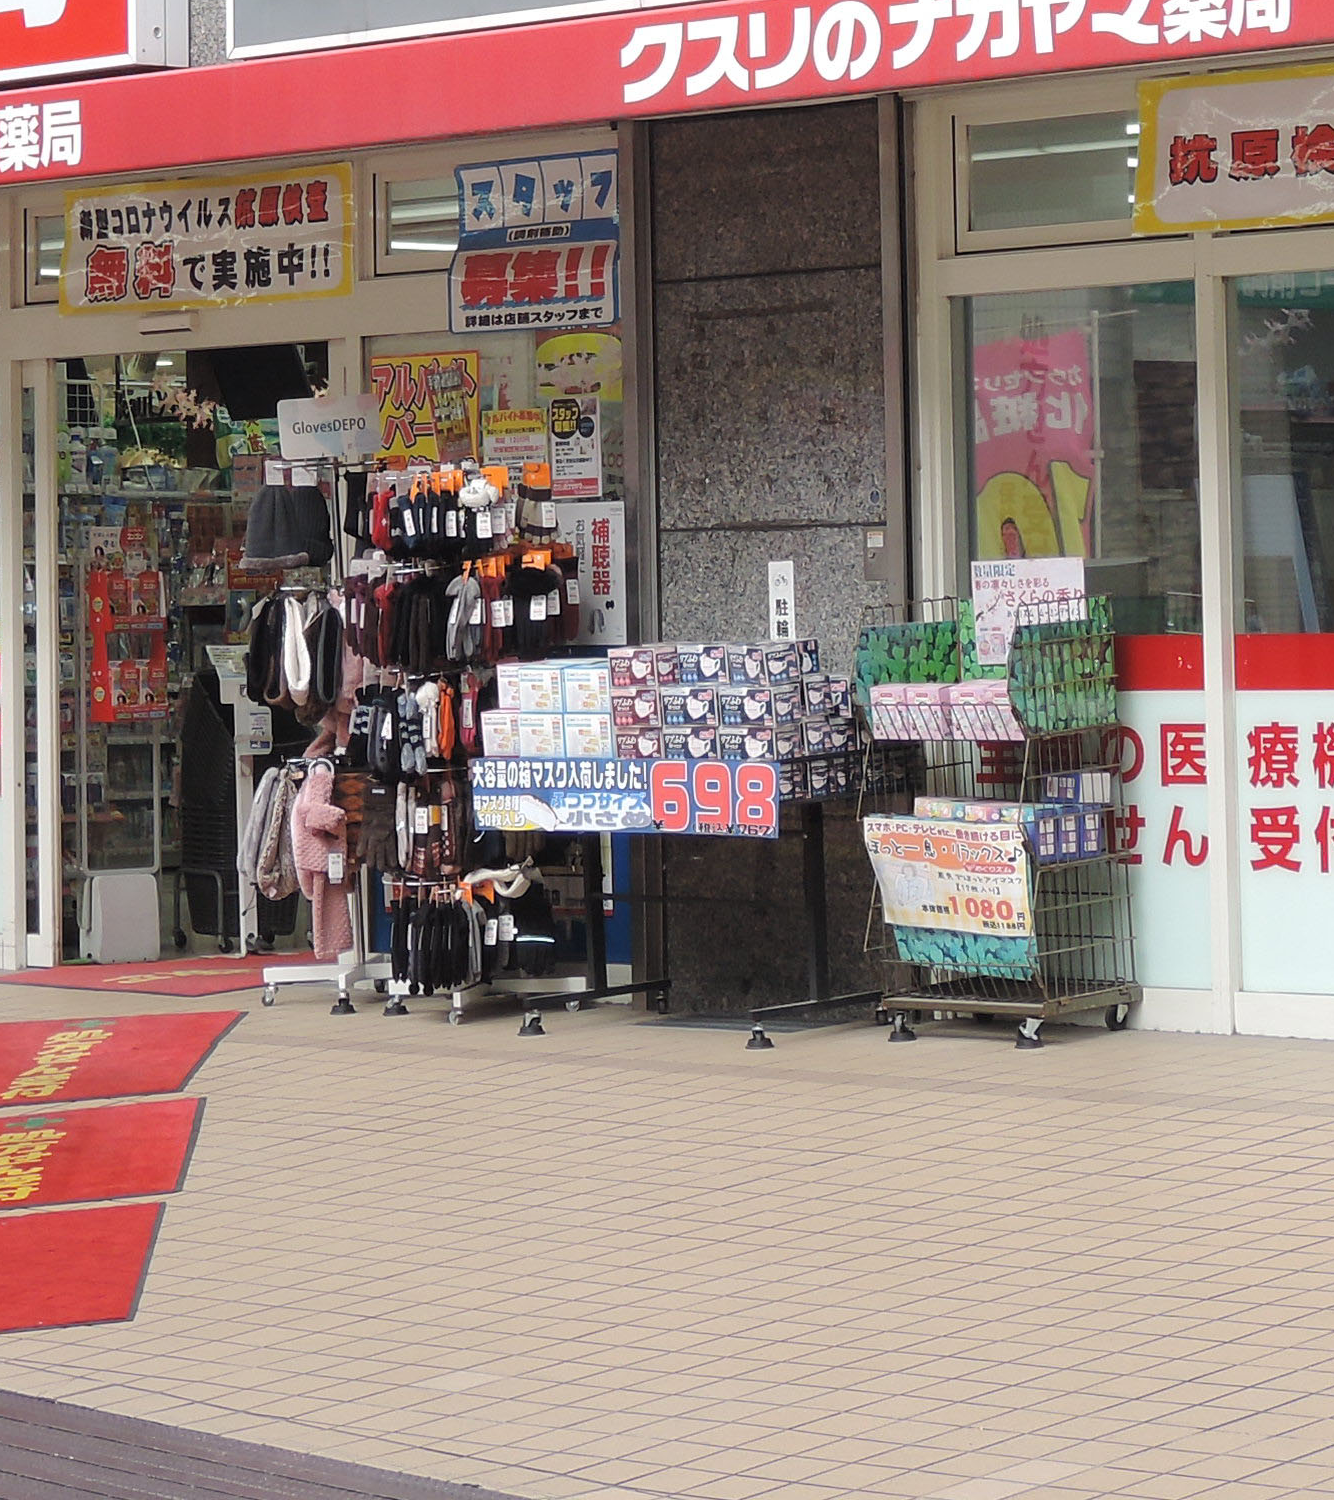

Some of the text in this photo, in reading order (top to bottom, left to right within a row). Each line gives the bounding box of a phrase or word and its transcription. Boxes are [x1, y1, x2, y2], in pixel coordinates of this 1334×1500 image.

[471, 170, 613, 221] スタッフ
[292, 417, 366, 435] GlovesDEPO
[592, 518, 611, 596] 補聴器
